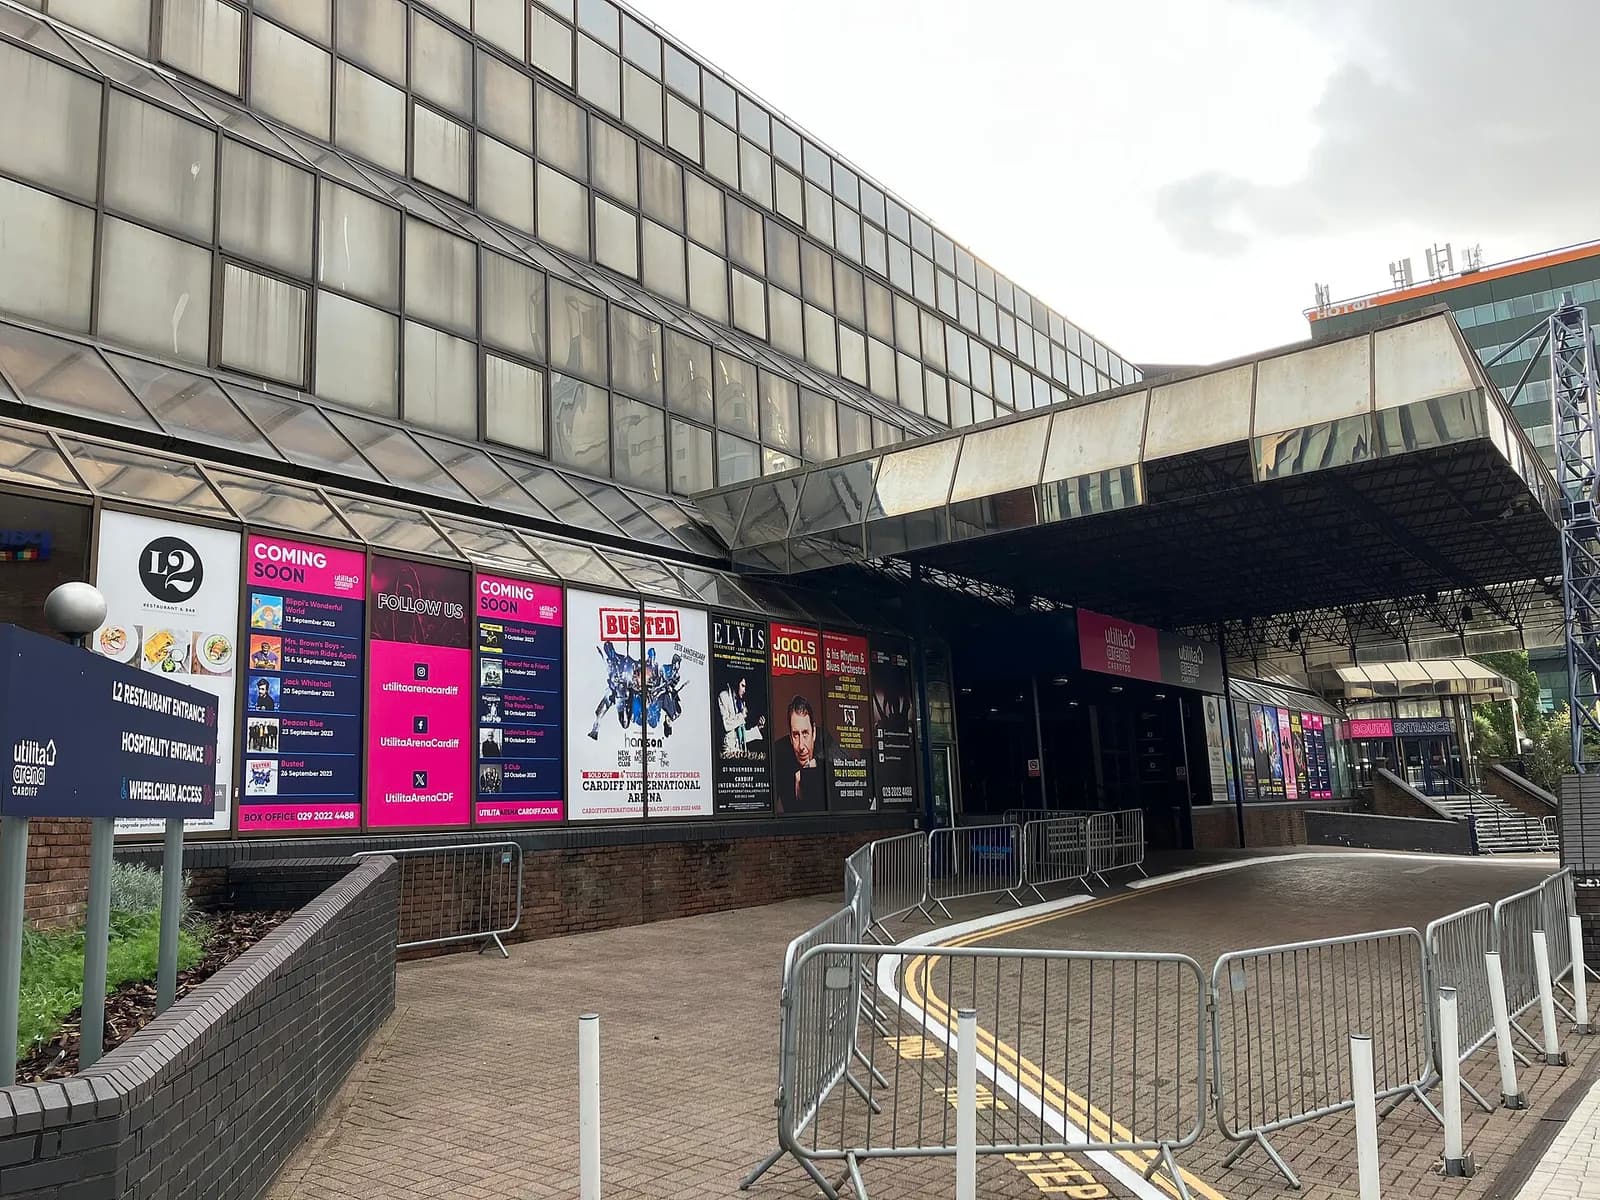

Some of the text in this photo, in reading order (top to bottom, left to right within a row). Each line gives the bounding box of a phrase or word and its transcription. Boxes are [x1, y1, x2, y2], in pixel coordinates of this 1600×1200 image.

[254, 543, 327, 568] COMING
[149, 549, 195, 593] L2
[254, 562, 304, 584] SOON
[480, 580, 534, 601] COMING
[143, 602, 178, 611] RESTAURANT
[286, 607, 305, 615] World
[310, 601, 342, 612] Wonderful
[378, 593, 464, 620] FOLLOW US
[481, 596, 518, 614] SOON
[292, 616, 322, 626] September
[606, 615, 675, 635] BUSTED
[713, 622, 765, 650] ELVIS
[1104, 626, 1128, 648] utilita
[299, 639, 322, 648] Brown's
[324, 642, 340, 650] Boys
[773, 636, 816, 654] JOOLS
[299, 648, 320, 656] Brown
[320, 650, 336, 658] Rides
[338, 652, 358, 660] Again
[826, 648, 830, 658] &
[840, 650, 859, 664] Rhythm
[860, 652, 864, 663] &
[1178, 644, 1198, 663] utilita
[303, 658, 332, 667] September
[504, 660, 522, 668] Funeral
[772, 652, 818, 672] HOLLAND
[826, 660, 866, 675] Blues Orchestra
[283, 678, 332, 688] Jack Whitehall
[382, 682, 458, 695] utilitaarenacardiff
[291, 688, 321, 696] September
[112, 680, 206, 724] L2 RESTAURANT ENTRANCE
[282, 719, 308, 727] Deacon
[1352, 722, 1450, 734] SOUTH ENTRANCE
[122, 732, 204, 764] HOSPITALITY ENTRANCE
[380, 737, 459, 748] UtilitaArenaCardiff
[14, 739, 46, 765] utilita
[13, 764, 46, 785] arena
[12, 786, 38, 797] CARDIFF
[129, 780, 202, 804] WHEELCHAIR ACCESS
[582, 780, 701, 791] CARDIFF INTERNATIONAL
[882, 786, 890, 797] 029
[891, 786, 902, 797] 2022
[385, 793, 454, 803] UtilitaArenaCDF
[244, 811, 354, 821] BOX OFFICE 029 2022 4488
